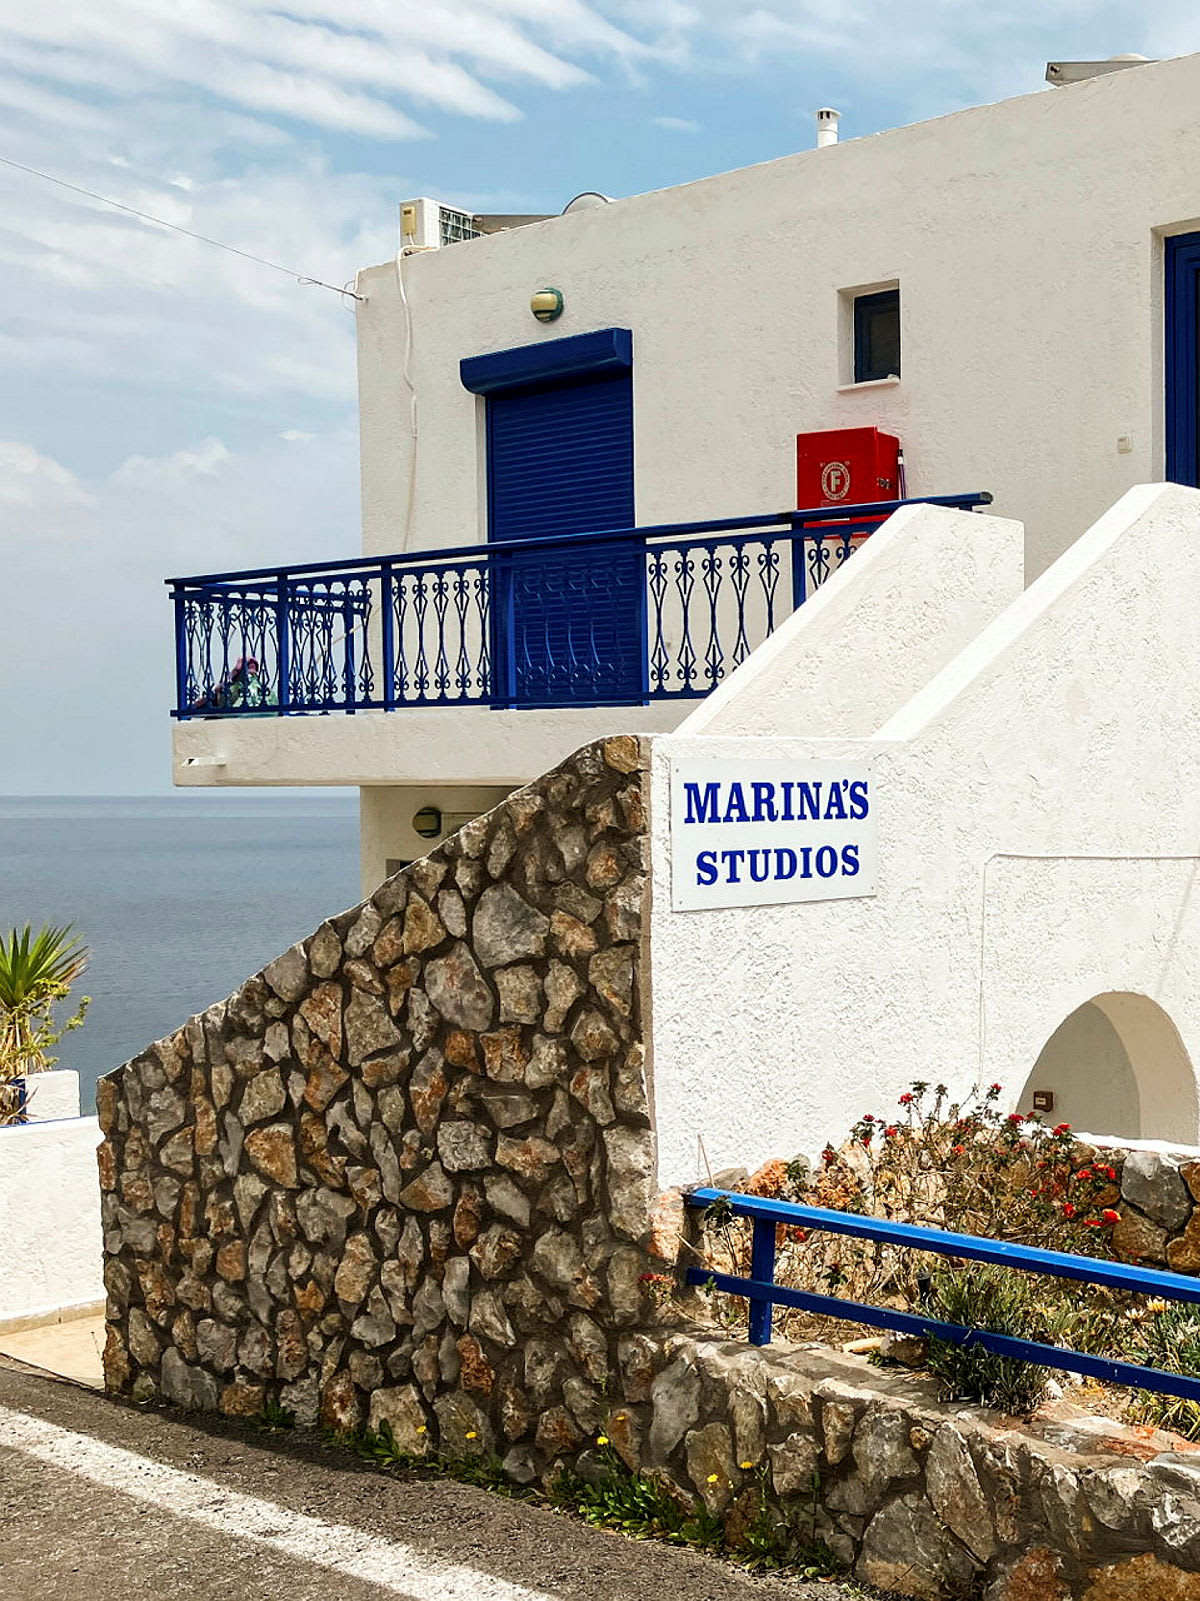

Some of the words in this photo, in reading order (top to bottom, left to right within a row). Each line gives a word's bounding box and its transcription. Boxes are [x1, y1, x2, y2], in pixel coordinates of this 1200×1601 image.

[830, 470, 841, 492] F
[683, 779, 870, 824] MARINA'S
[696, 844, 860, 886] STUDIOS
